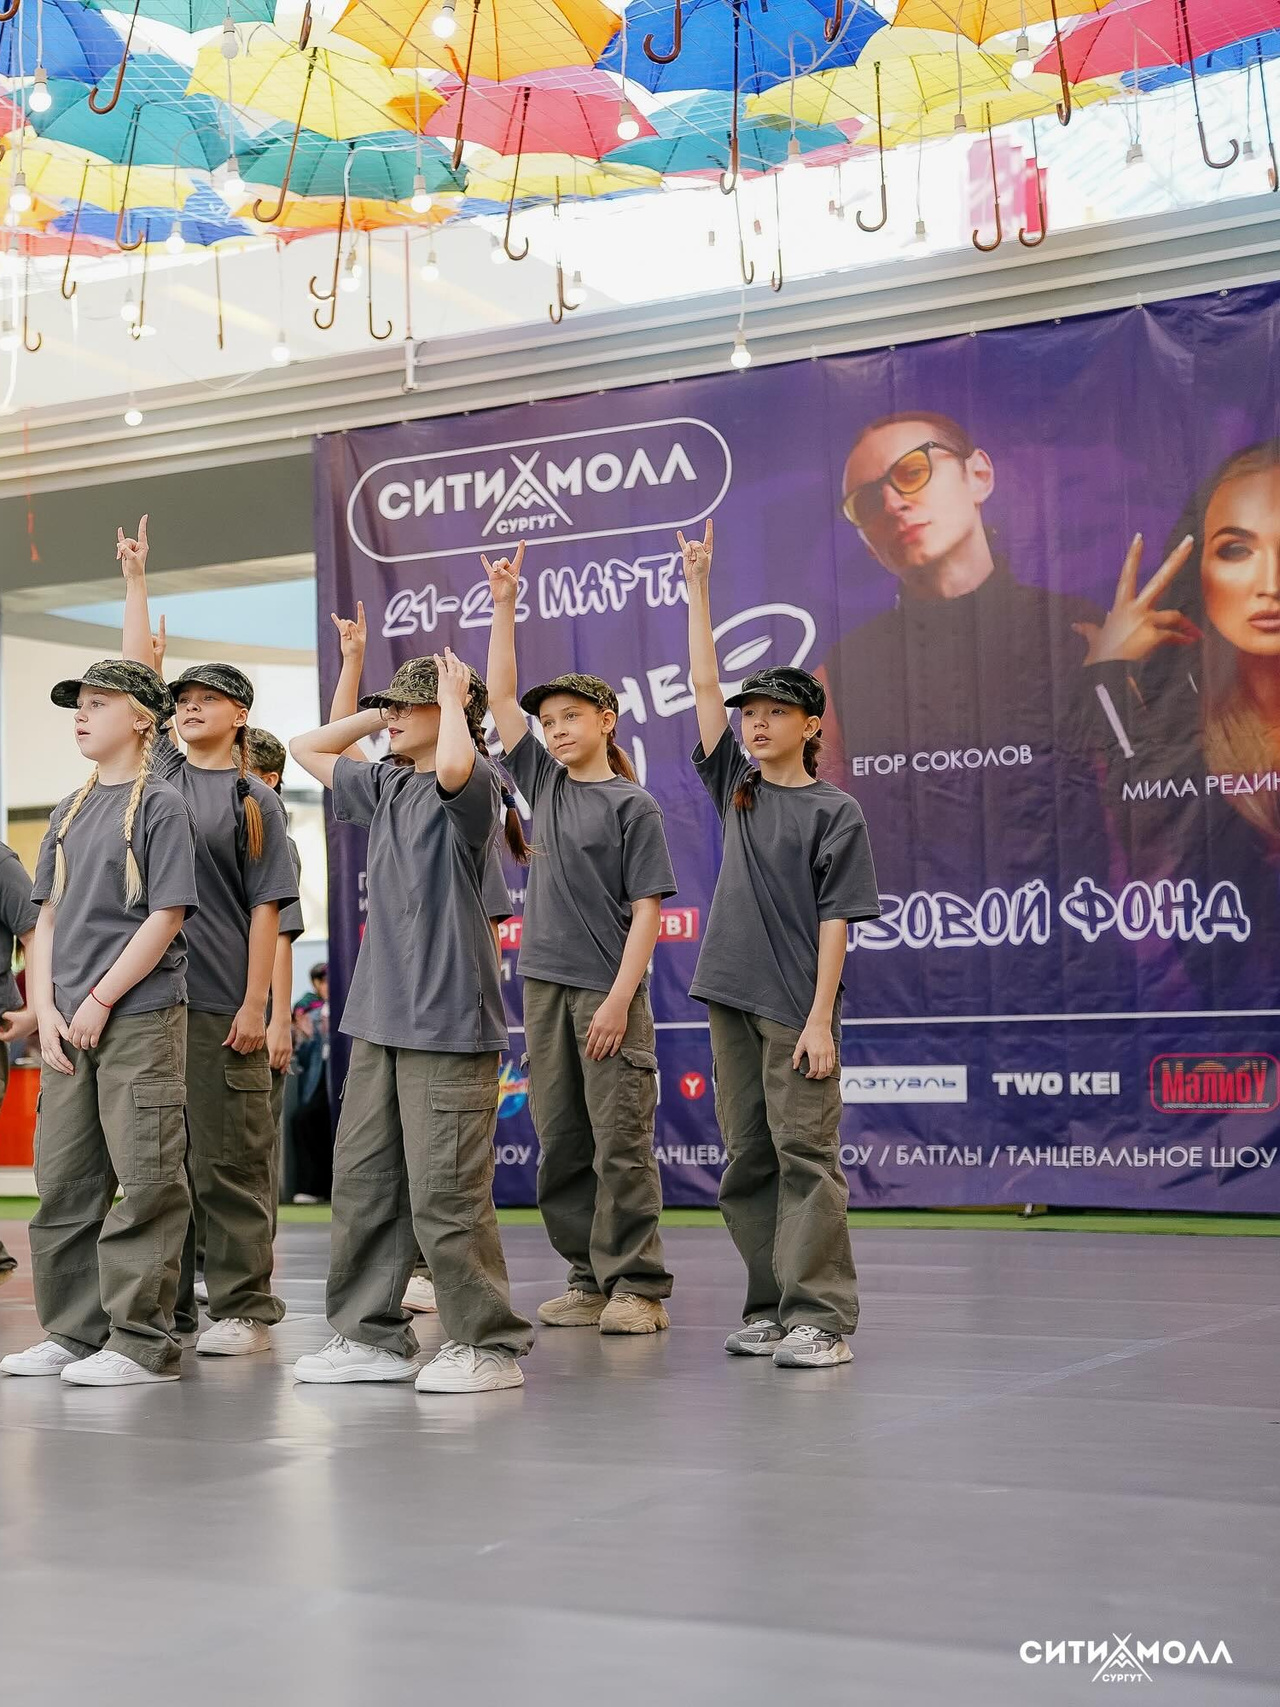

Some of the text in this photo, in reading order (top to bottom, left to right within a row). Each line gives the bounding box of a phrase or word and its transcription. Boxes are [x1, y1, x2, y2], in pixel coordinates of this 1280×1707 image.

[377, 442, 698, 521] СИТИ МОЛЛ
[495, 513, 558, 535] СУРГУТ
[852, 744, 1033, 777] ЕГОР СОКОЛОВ
[1122, 777, 1199, 801] МИЛА
[1058, 876, 1251, 944] ФОНД
[991, 1071, 1120, 1096] TWO KEI
[895, 1144, 983, 1167] БАТТЛЫ
[1005, 1145, 1203, 1169] ТАНЦЕВАЛЬНОЕ
[1210, 1145, 1278, 1169] ШОУ
